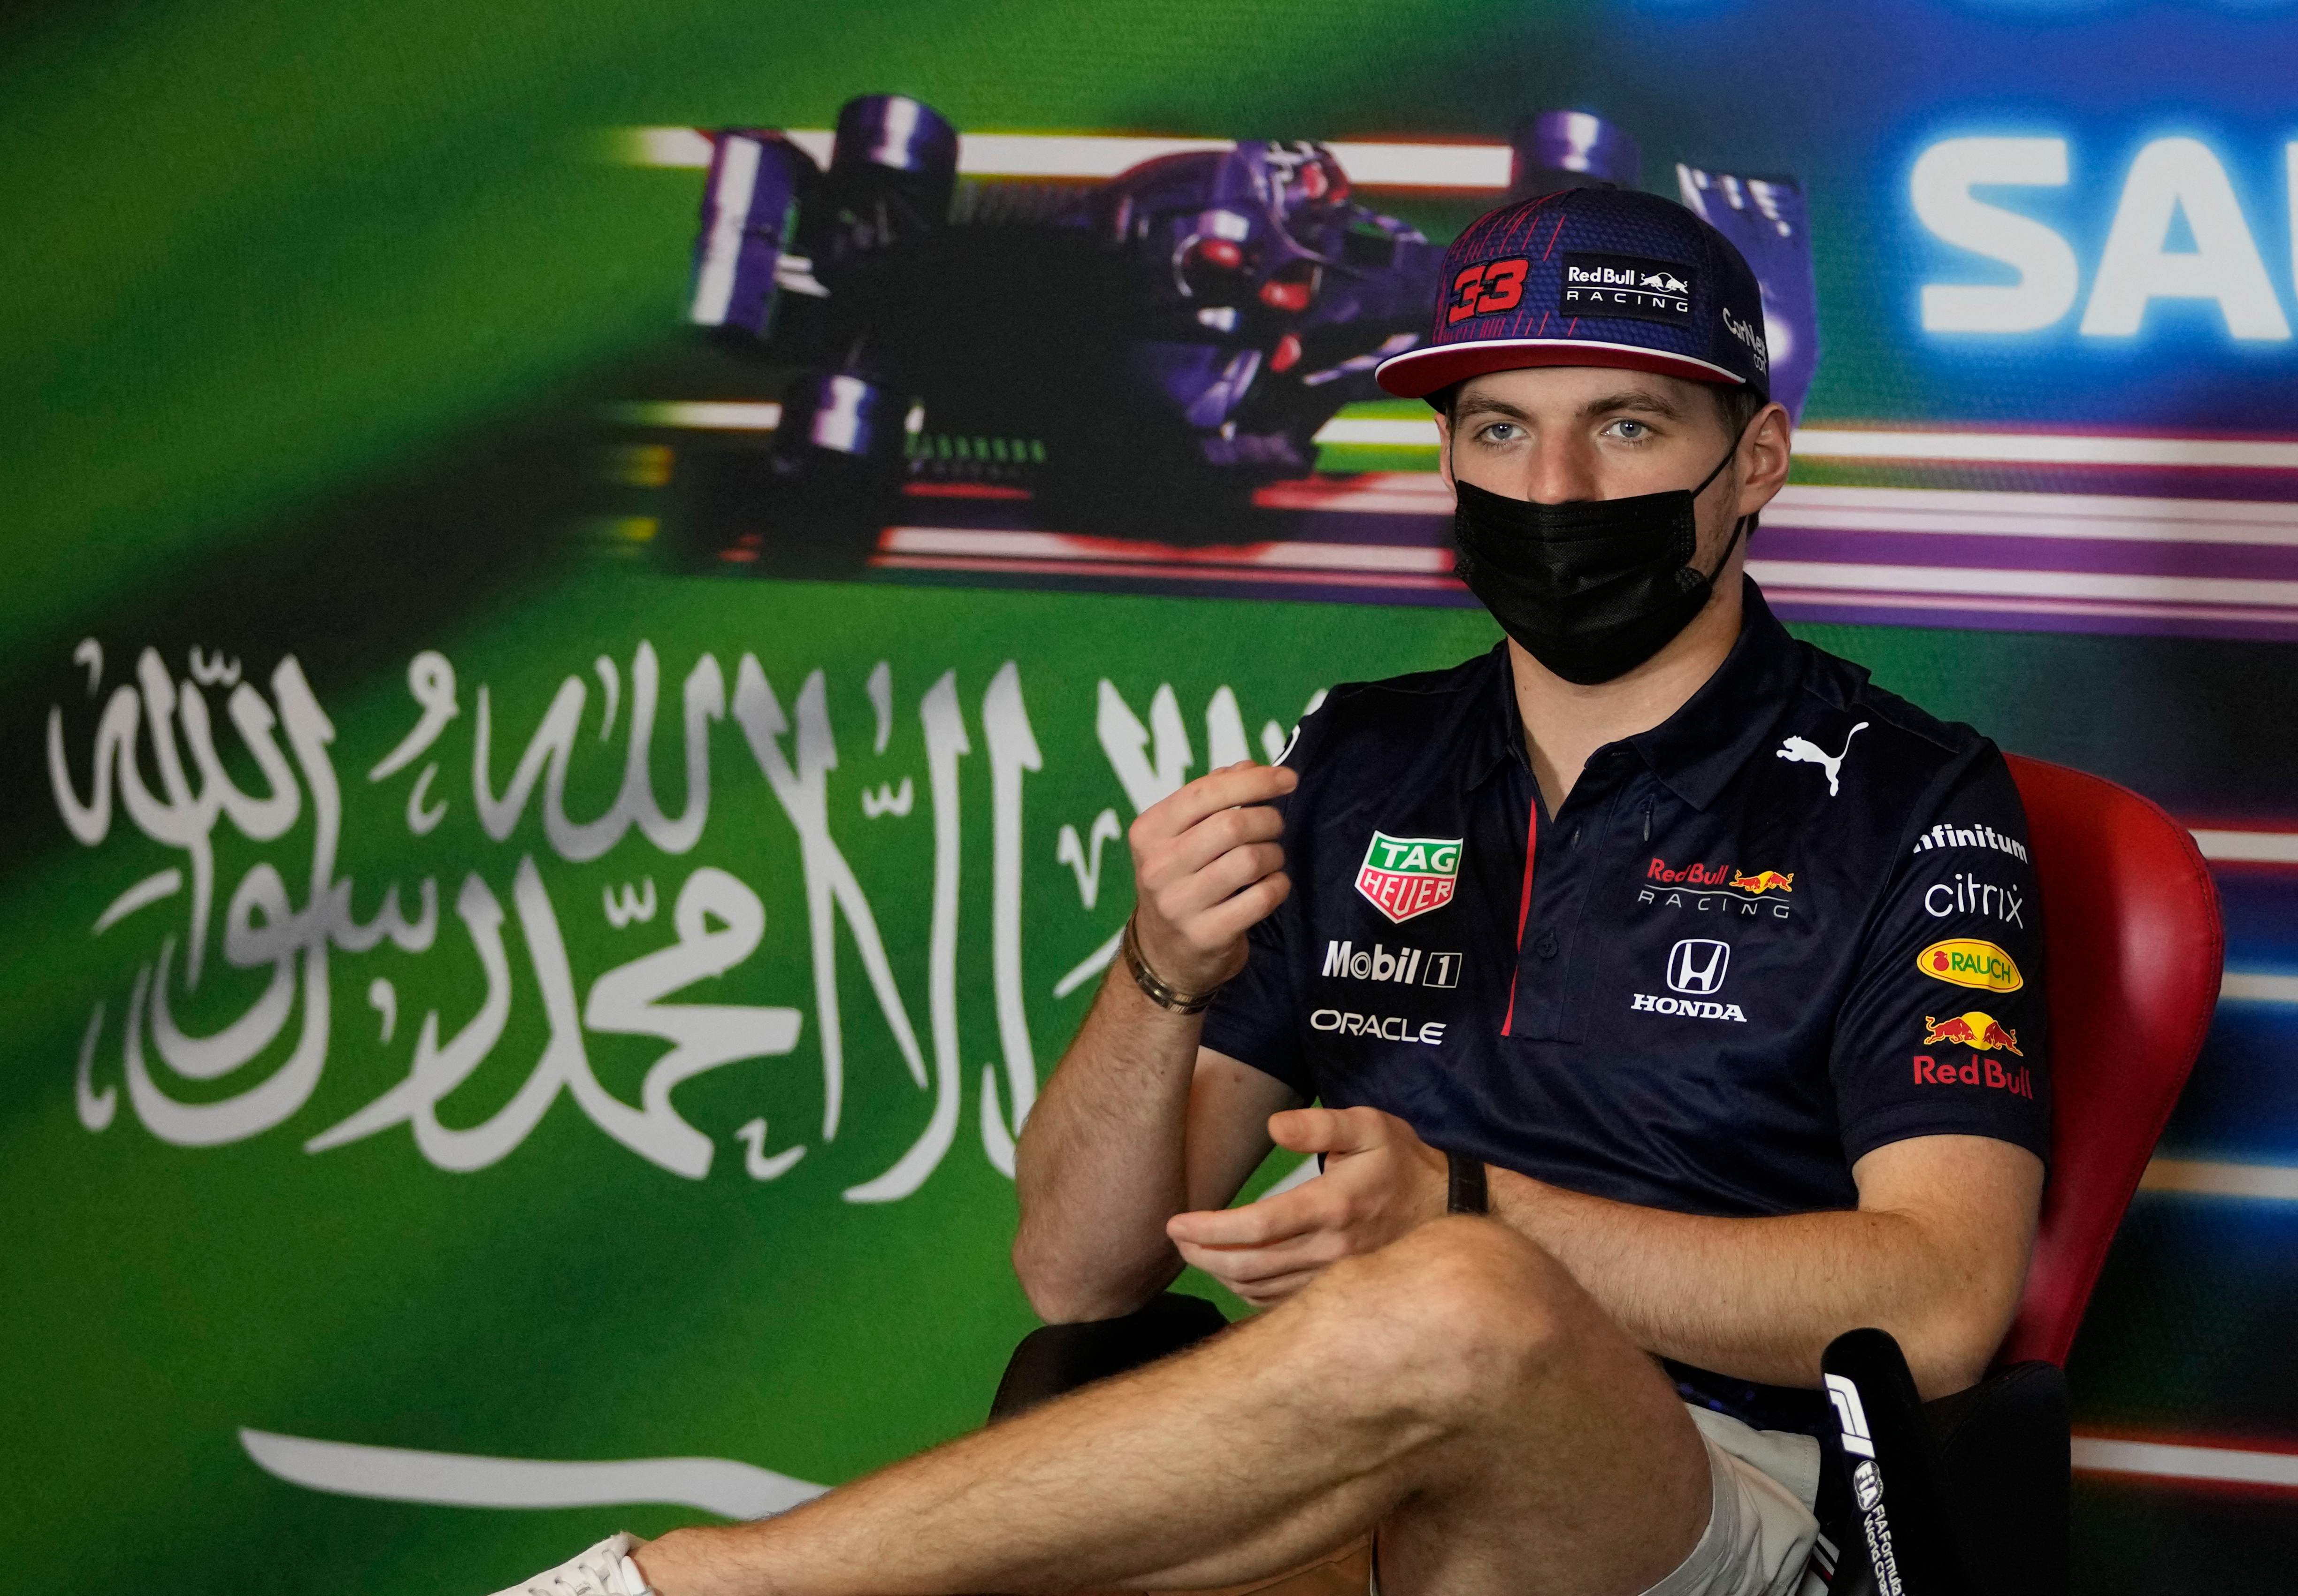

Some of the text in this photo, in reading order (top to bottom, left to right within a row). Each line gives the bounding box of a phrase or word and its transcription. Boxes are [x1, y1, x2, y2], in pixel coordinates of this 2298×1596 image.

[1910, 136, 2298, 341] SA
[1448, 258, 1530, 325] 33
[1568, 266, 1635, 285] Red Bull
[1567, 291, 1688, 313] RACING
[1380, 842, 1457, 872] TAG
[1913, 824, 2028, 865] nfinitum
[1647, 857, 1729, 885] Red Bull
[1363, 871, 1453, 915] HEUER
[1638, 890, 1790, 919] RACING
[1925, 873, 2023, 929] citrix
[1322, 940, 1422, 984] Mobil
[1952, 952, 2010, 984] RAUCH
[1631, 993, 1747, 1022] HONDA
[1310, 1009, 1447, 1045] ORACLE
[1913, 1054, 2033, 1099] Red Bull
[1872, 1504, 1902, 1596] FIA Formula
